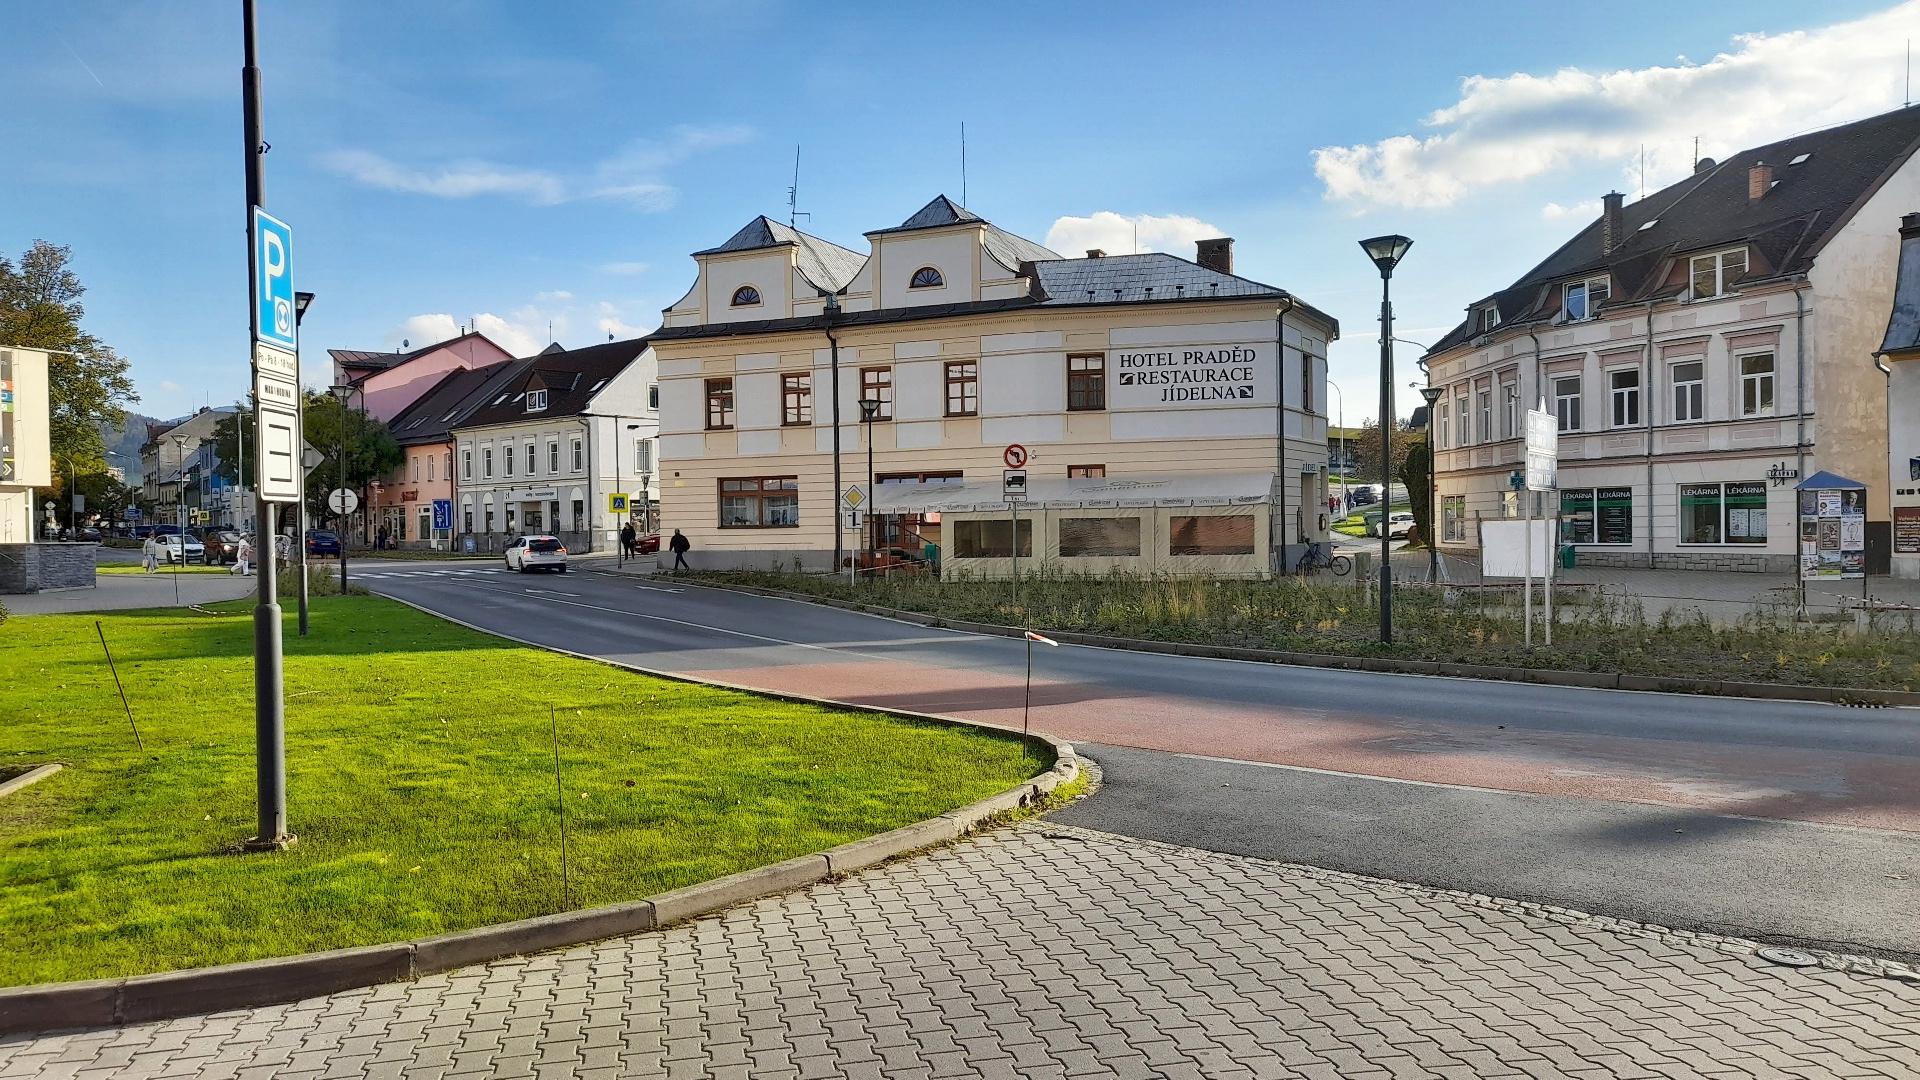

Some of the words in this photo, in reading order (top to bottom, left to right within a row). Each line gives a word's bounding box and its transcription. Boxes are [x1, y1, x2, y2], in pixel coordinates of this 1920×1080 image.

[264, 228, 285, 301] P
[1120, 352, 1178, 367] HOTEL
[1183, 346, 1256, 365] PRADĚD
[1137, 367, 1254, 385] RESTAURACE
[1161, 385, 1236, 401] JÍDELNA
[1682, 488, 1720, 496] LÉKÁRNA
[1727, 486, 1765, 495] LÉKÁRNA
